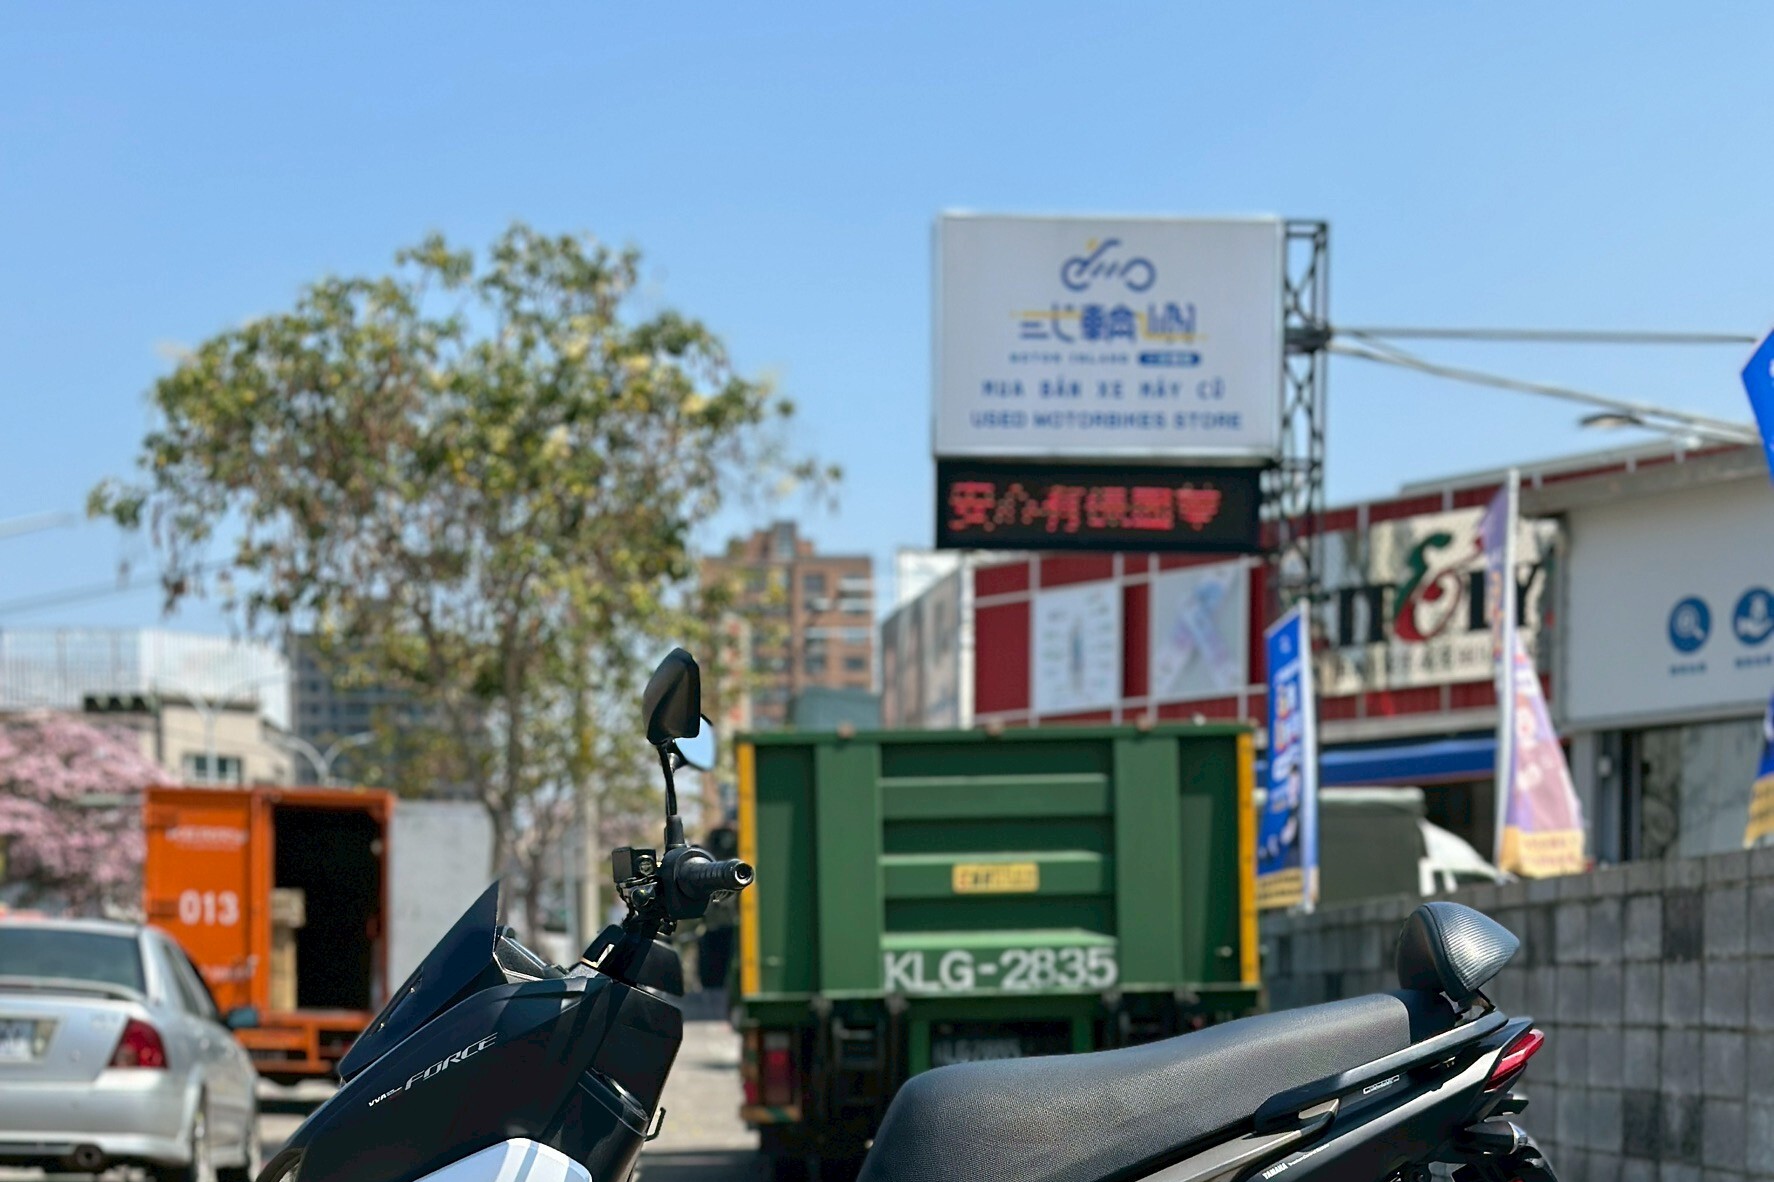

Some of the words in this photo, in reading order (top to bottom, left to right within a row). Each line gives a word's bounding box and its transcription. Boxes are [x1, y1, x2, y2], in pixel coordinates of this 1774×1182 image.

[969, 410, 1029, 430] USED
[1034, 410, 1166, 430] MOTORBIKES
[1172, 410, 1242, 430] STORE
[178, 889, 240, 926] 013
[883, 946, 1119, 992] KLG-2835
[404, 1032, 498, 1090] FORCE
